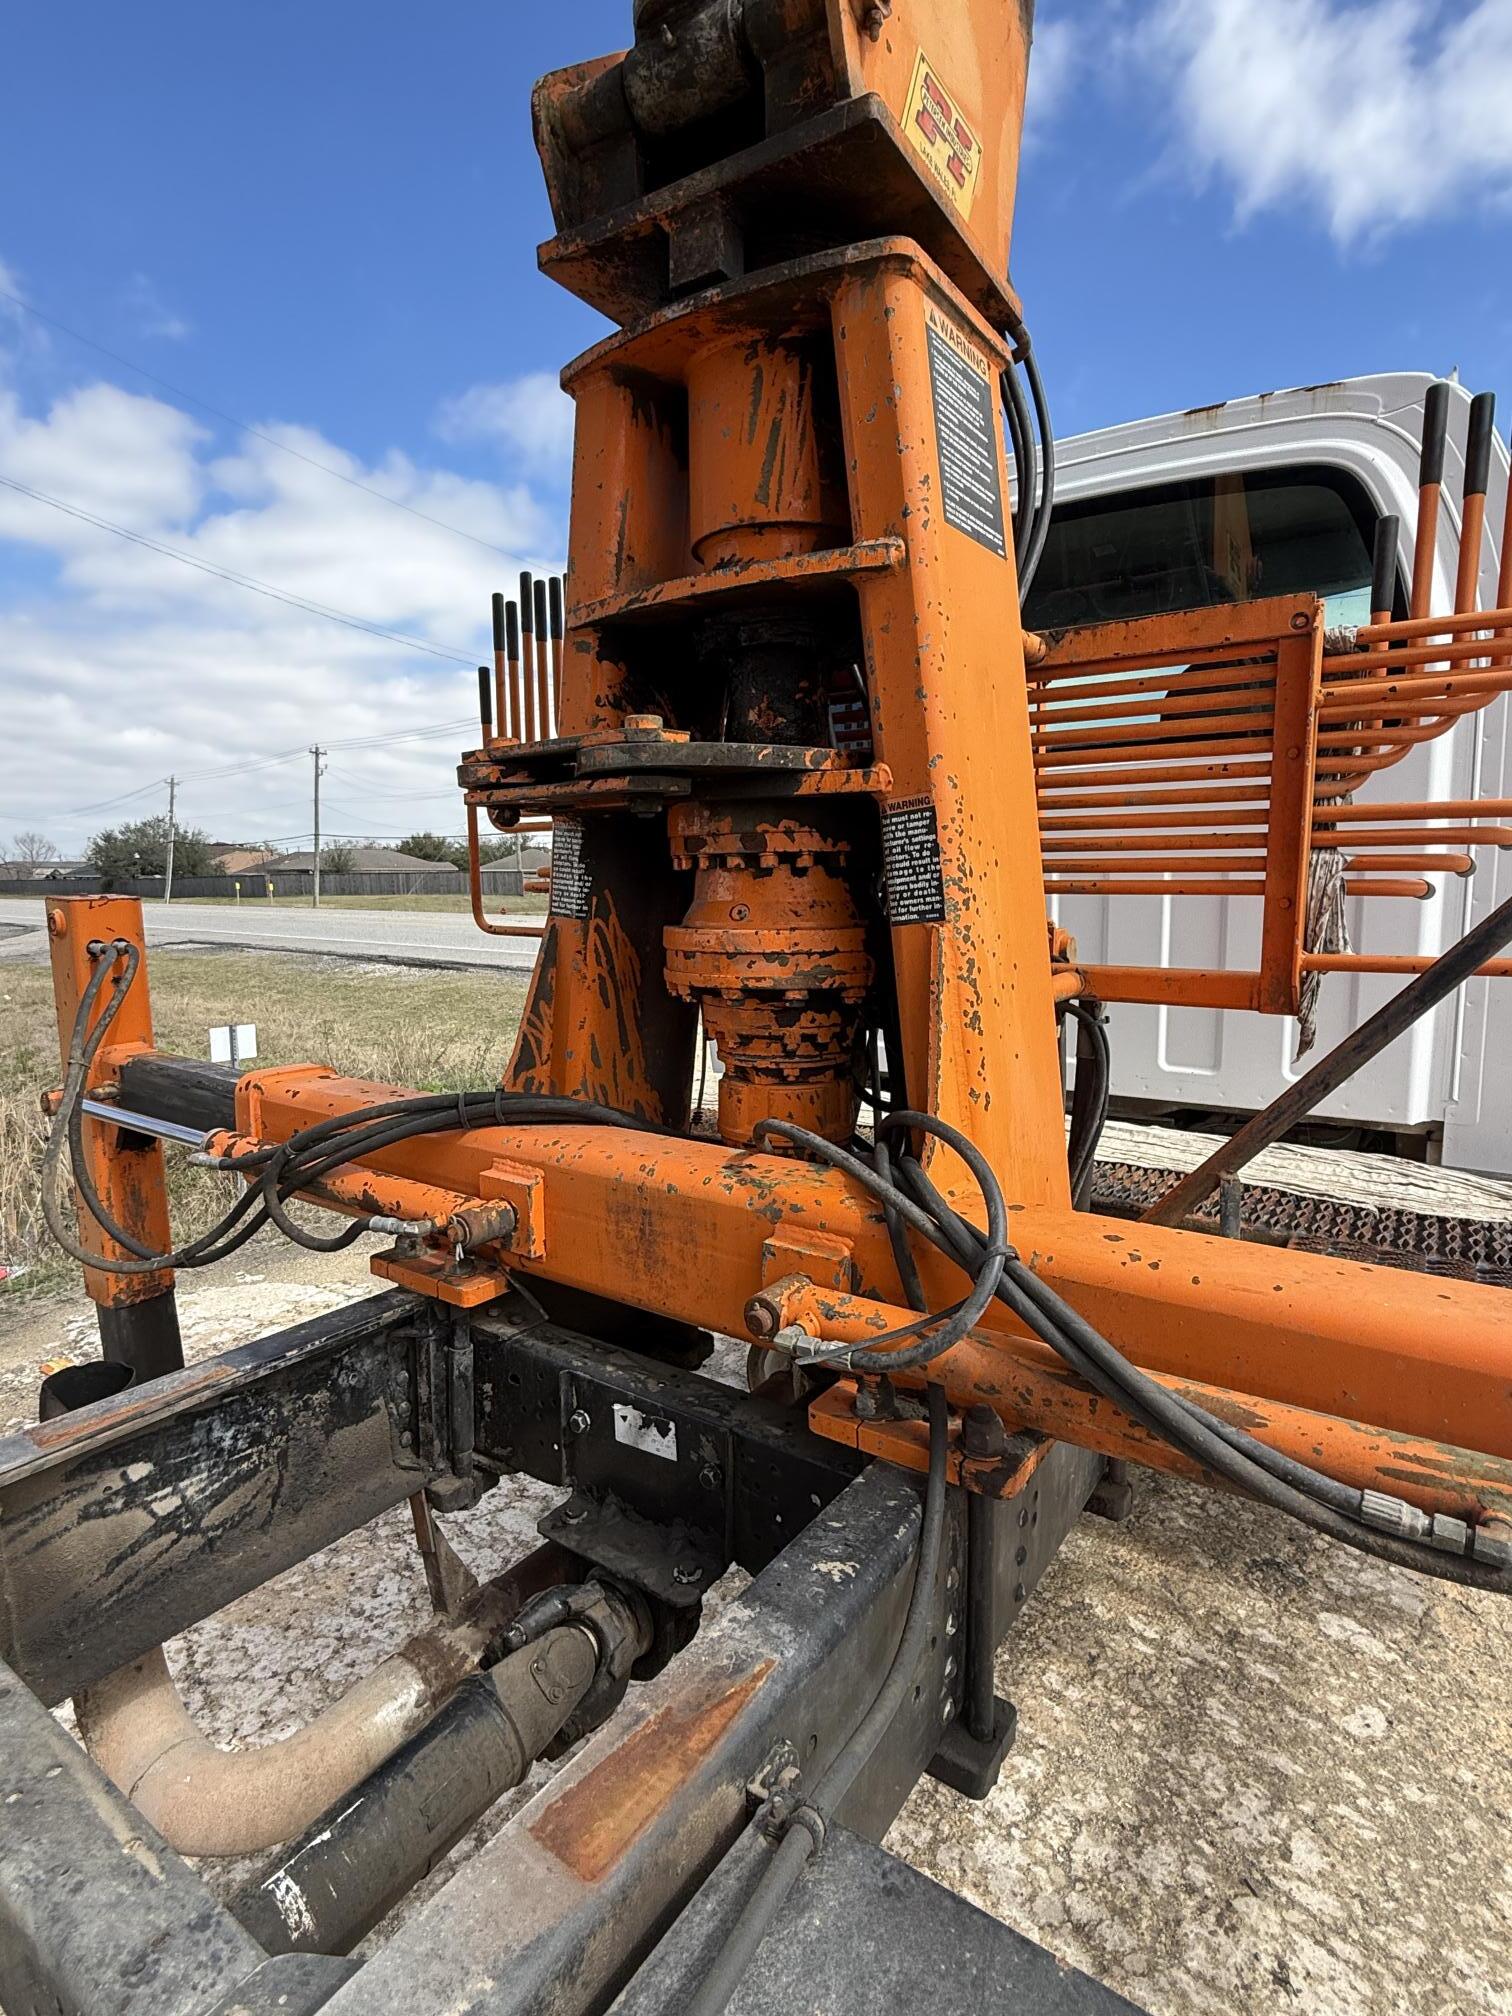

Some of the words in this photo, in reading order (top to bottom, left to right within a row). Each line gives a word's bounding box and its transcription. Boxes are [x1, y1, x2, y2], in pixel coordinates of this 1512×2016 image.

[922, 92, 946, 130] PETERSEN
[945, 126, 971, 167] INDUSTRIES
[938, 317, 987, 376] WARNING
[888, 796, 931, 812] WARNING
[891, 814, 908, 823] must
[910, 811, 921, 820] not
[906, 819, 930, 829] tamper
[895, 830, 906, 838] the
[907, 828, 928, 836] manu-
[911, 833, 936, 843] settings
[892, 846, 901, 854] oil
[904, 844, 921, 852] flow
[892, 860, 910, 869] could
[911, 857, 931, 866] result
[909, 880, 929, 889] bodily
[913, 887, 939, 896] death.
[900, 897, 924, 906] owners
[909, 904, 932, 912] further
